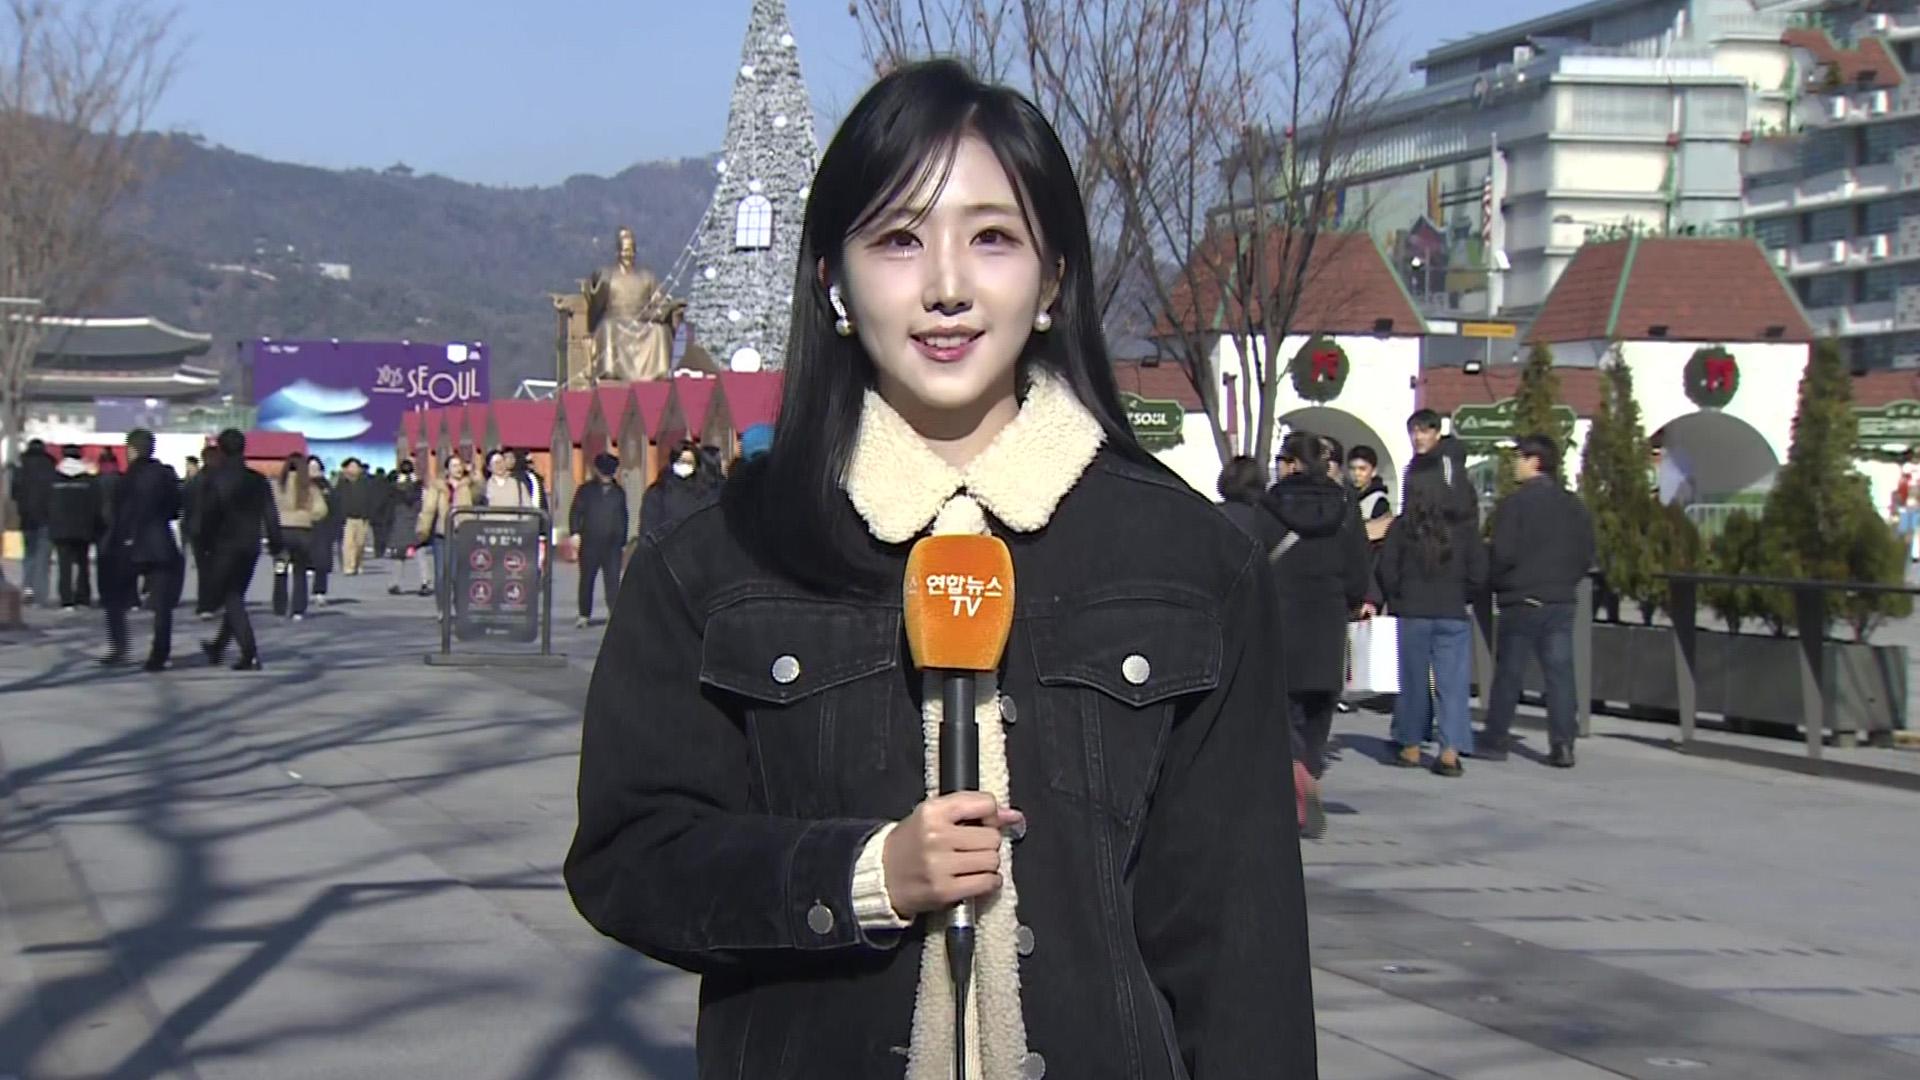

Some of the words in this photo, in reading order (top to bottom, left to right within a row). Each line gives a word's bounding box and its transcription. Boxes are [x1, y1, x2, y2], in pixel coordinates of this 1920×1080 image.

[406, 365, 481, 404] SEOUL
[926, 574, 1003, 597] 연합뉴스
[949, 596, 983, 617] TV
